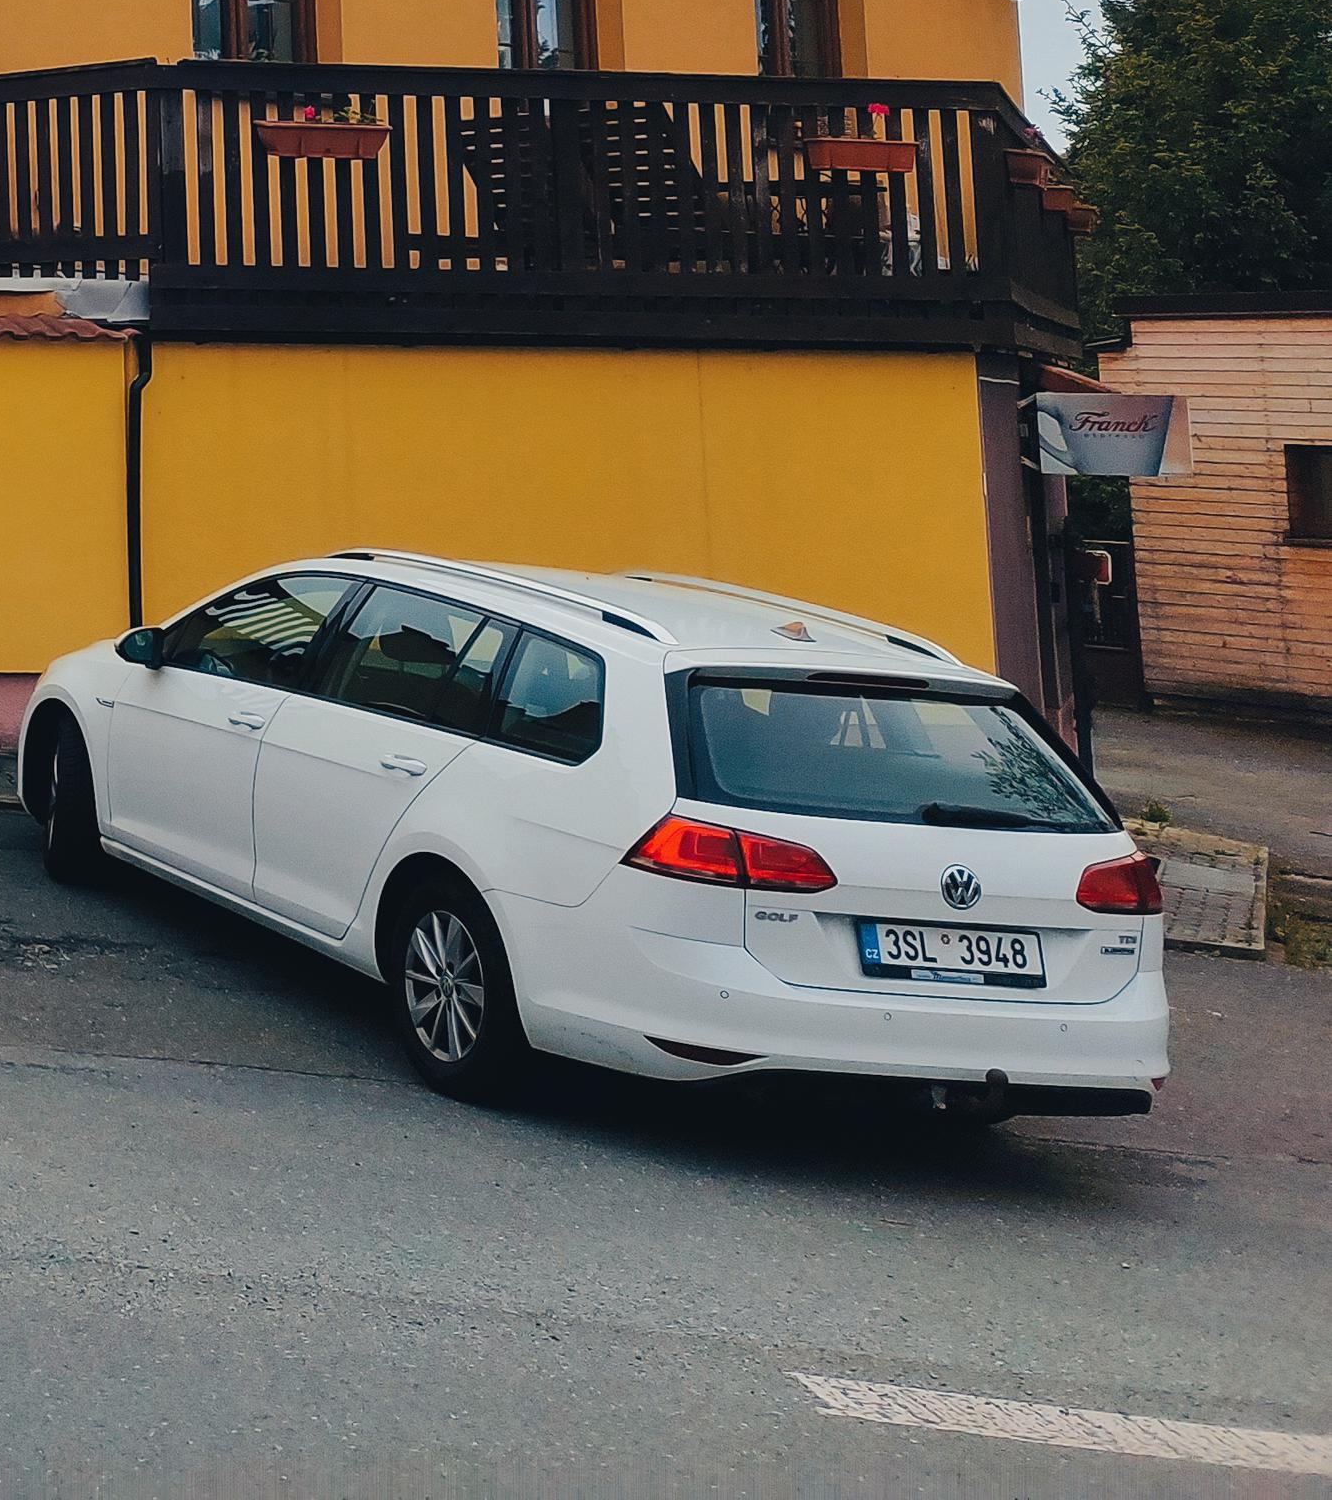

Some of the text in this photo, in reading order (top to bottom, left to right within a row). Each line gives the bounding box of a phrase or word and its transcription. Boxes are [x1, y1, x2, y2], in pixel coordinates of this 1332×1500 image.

[1069, 411, 1158, 433] Franck
[755, 911, 799, 923] GOLF
[865, 928, 1028, 970] CZ 3SL 3948
